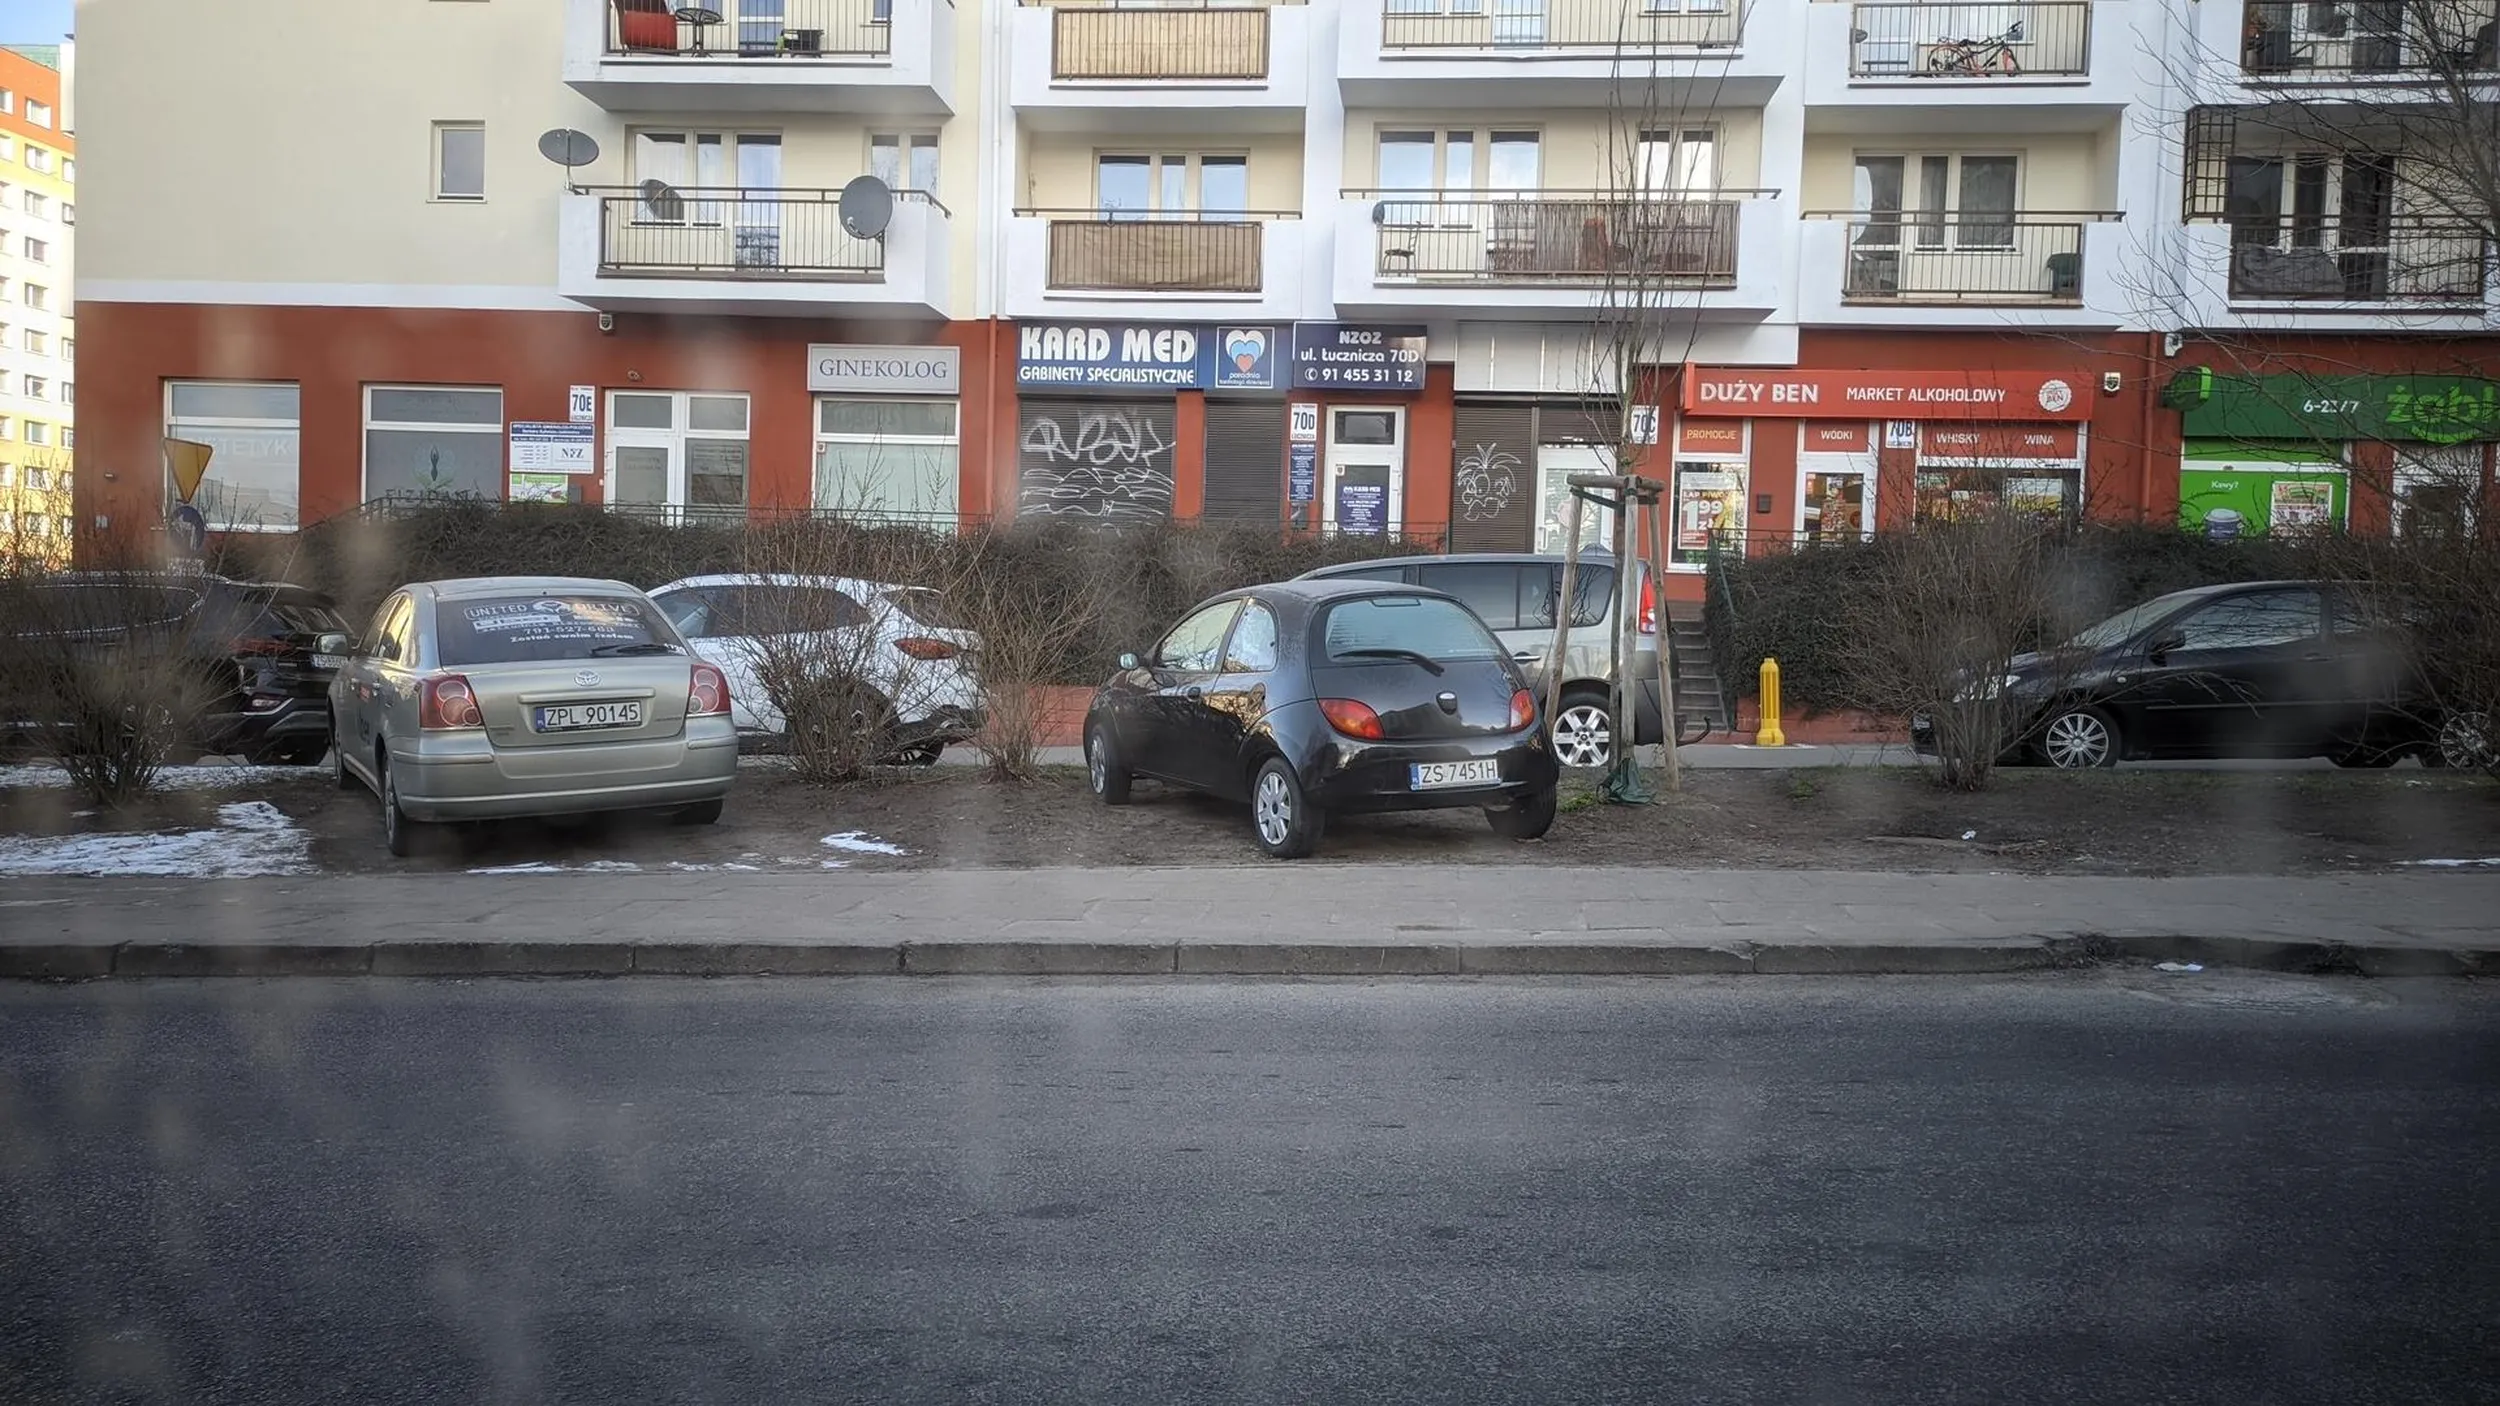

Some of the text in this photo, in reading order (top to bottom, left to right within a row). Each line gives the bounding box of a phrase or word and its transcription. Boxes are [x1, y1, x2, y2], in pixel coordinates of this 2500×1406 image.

[1020, 327, 1197, 363] KARD MED
[1338, 331, 1382, 344] NZOZ
[1300, 348, 1420, 362] ul. Łucznicza 70D
[818, 358, 949, 380] GINEKOLOG
[1020, 365, 1194, 383] GABINETY SPECJALISTYCZNE
[1322, 368, 1413, 382] 91 455 31 12
[1700, 379, 1820, 403] DUŻY BEN
[1846, 387, 2006, 403] MARKET ALKOHOLOWY
[572, 394, 593, 412] 70E
[1293, 411, 1315, 430] 70D
[1633, 414, 1656, 433] 70C
[1889, 419, 1913, 437] 70B
[1686, 429, 1738, 440] PROMOCJE
[1820, 427, 1853, 440] WÓDKI
[1936, 433, 1981, 444] WHISKY
[2024, 434, 2055, 445] WINA
[561, 447, 584, 459] NFZ
[470, 604, 527, 618] UNITED
[546, 703, 639, 726] ZPL 90145
[1421, 761, 1496, 783] ZS 7451H
